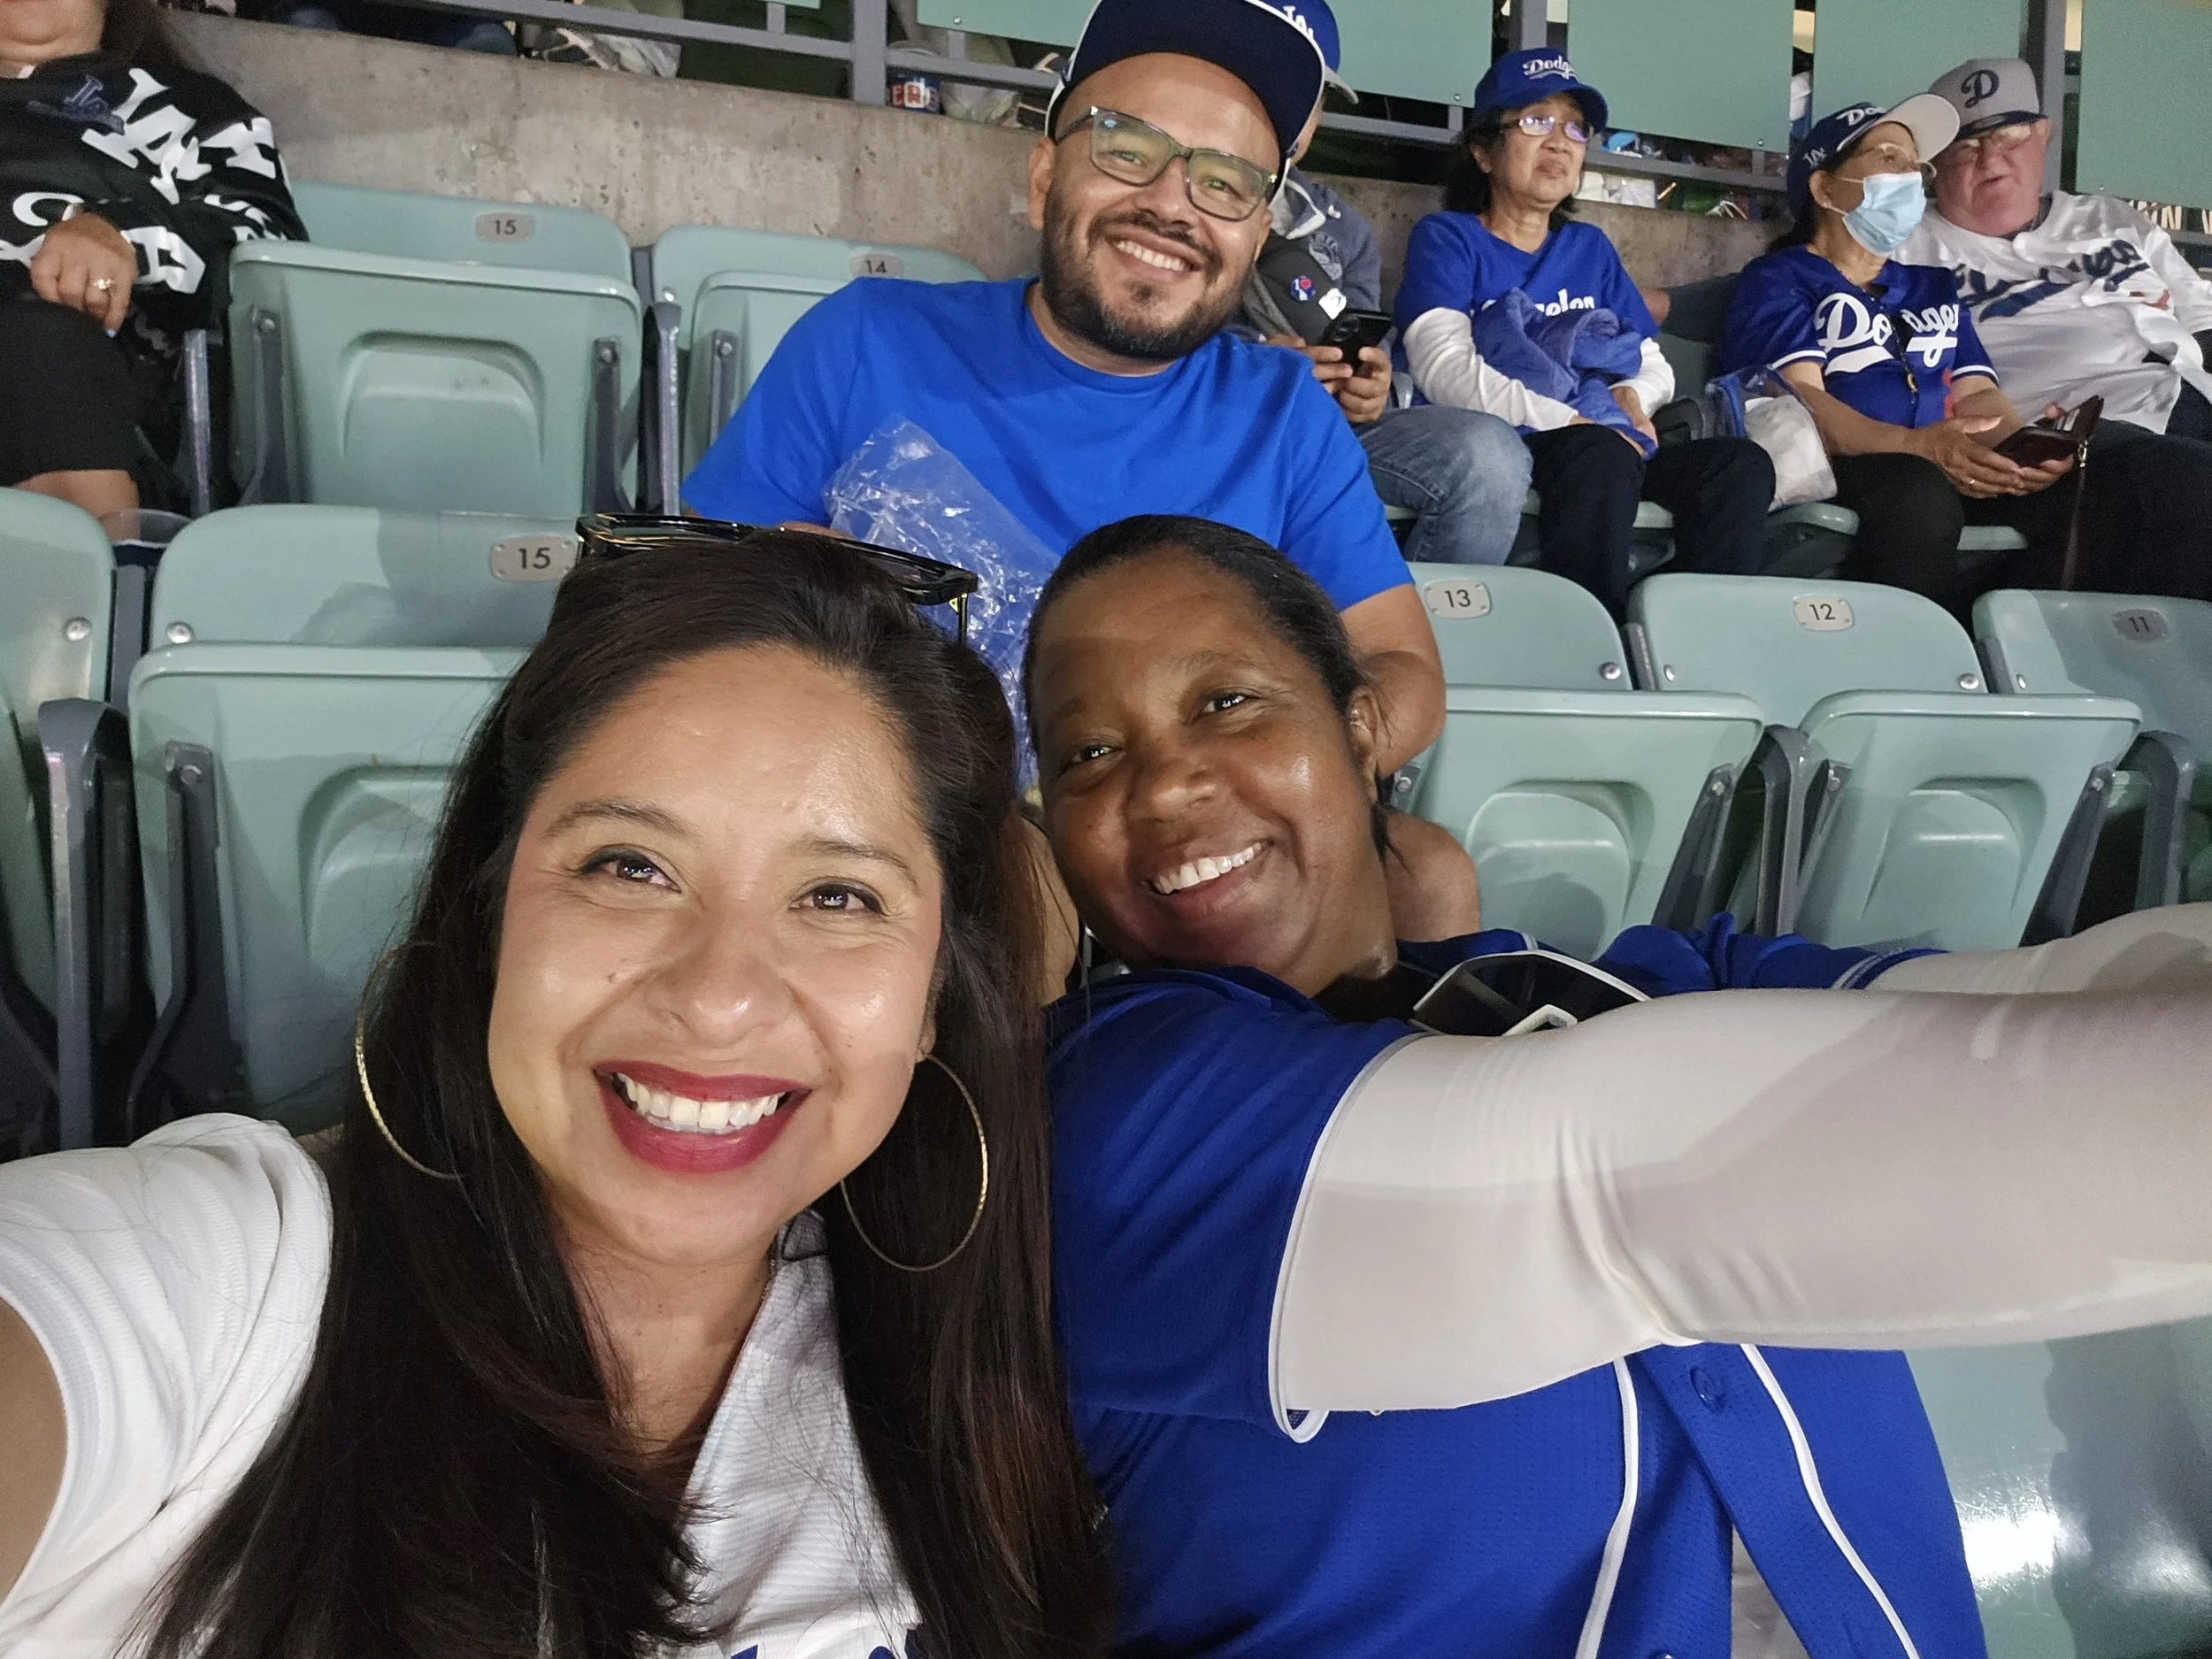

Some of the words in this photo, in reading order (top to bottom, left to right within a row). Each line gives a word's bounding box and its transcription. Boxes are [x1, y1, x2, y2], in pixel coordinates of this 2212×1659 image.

[1523, 54, 1577, 80] Dodg
[1961, 69, 2000, 109] D
[494, 219, 517, 235] 15
[866, 260, 887, 274] 14
[518, 547, 551, 569] 15
[1444, 589, 1471, 608] 13
[1809, 603, 1836, 621] 12
[2129, 616, 2150, 633] 11
